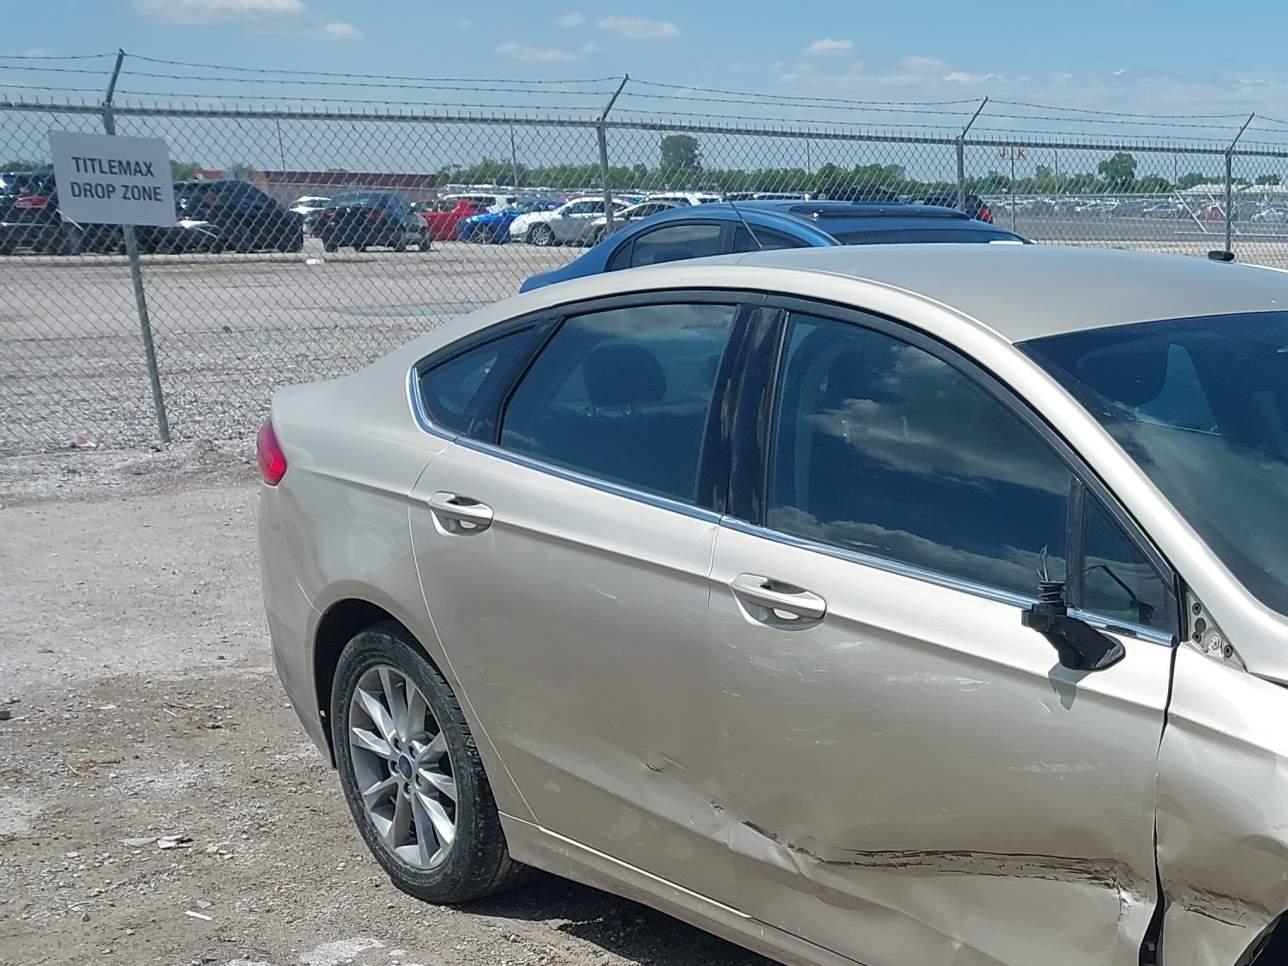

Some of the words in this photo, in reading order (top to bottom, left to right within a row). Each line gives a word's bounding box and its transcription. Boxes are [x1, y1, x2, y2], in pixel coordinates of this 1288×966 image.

[71, 156, 155, 178] TITLEMAX
[70, 181, 116, 200] DROP
[120, 184, 163, 202] ZONE
